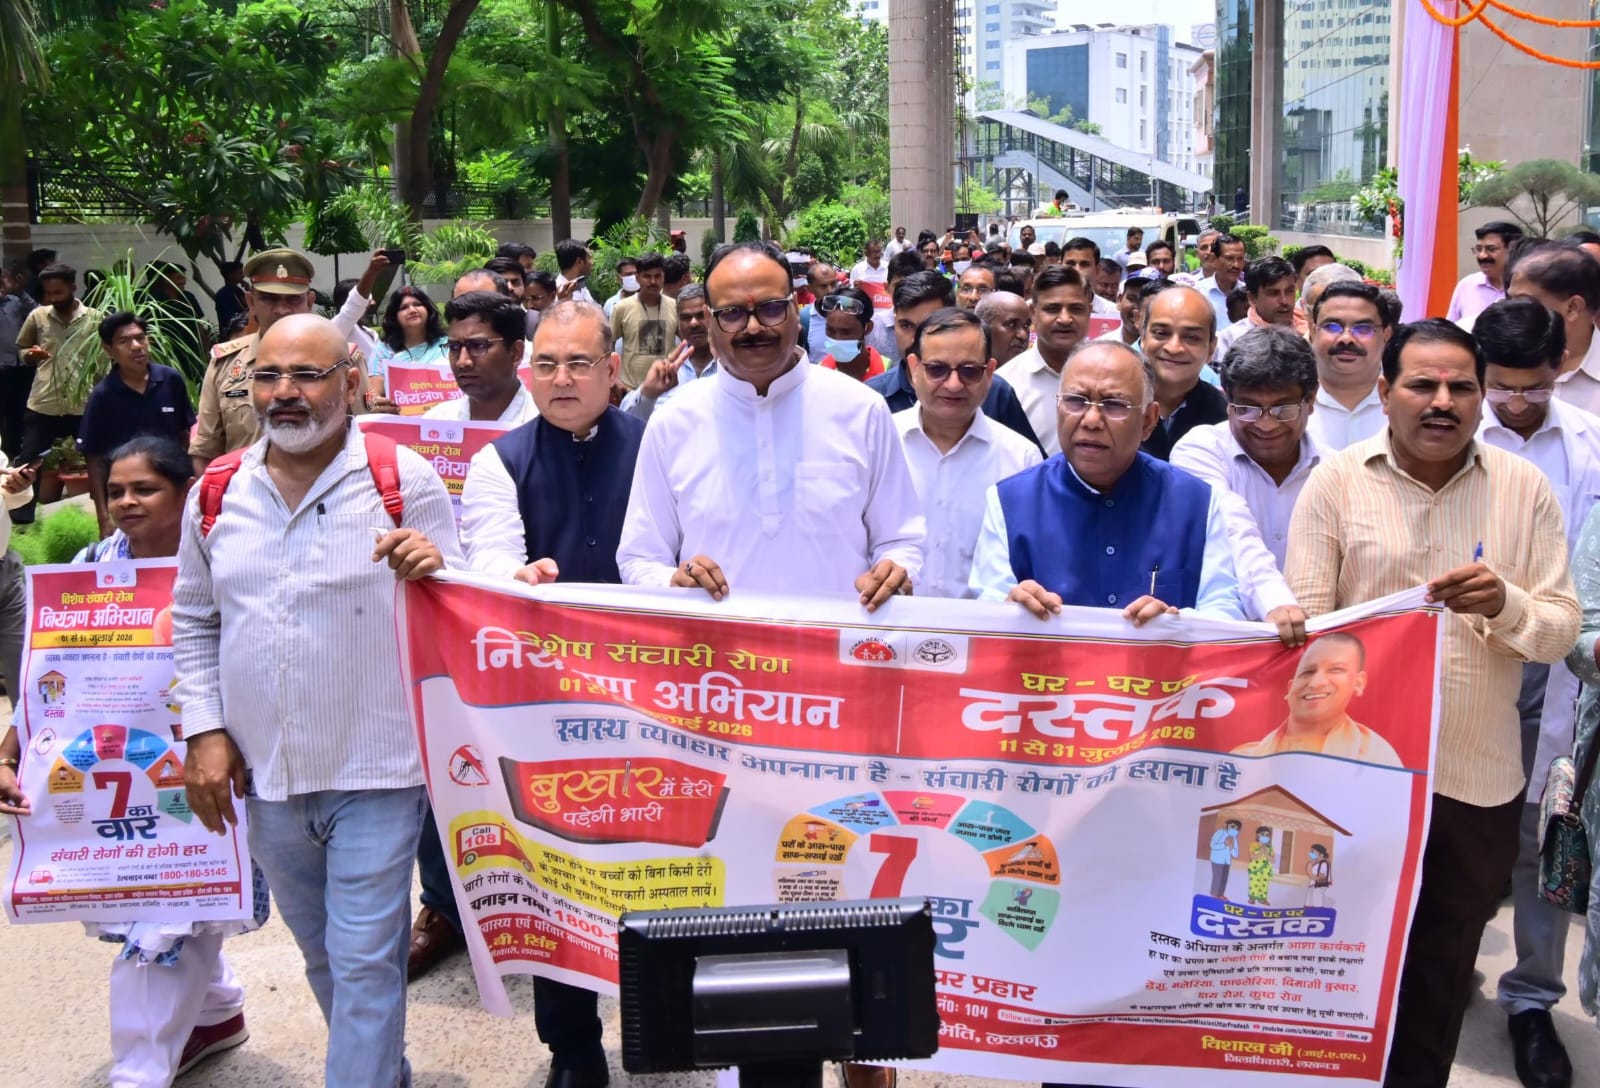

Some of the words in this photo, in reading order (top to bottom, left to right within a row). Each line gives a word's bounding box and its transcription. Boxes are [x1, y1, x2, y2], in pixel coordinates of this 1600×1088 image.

[442, 444, 461, 456] रोग
[62, 592, 84, 605] विशेष
[86, 591, 113, 604] संचारी
[116, 590, 135, 603] रोग
[39, 606, 90, 629] नियंत्रण
[91, 603, 155, 627] अभियान
[604, 640, 716, 668] संचारी
[725, 648, 793, 674] रोग
[1021, 672, 1069, 692] घर
[1107, 675, 1154, 695] घर
[560, 677, 581, 692] 01
[708, 720, 753, 737] 2026
[653, 671, 846, 729] अभियान
[960, 677, 1248, 740] दस्तक
[44, 709, 65, 719] दस्तक
[998, 740, 1017, 752] 11
[1022, 739, 1048, 757] से
[1053, 746, 1073, 758] 31
[1152, 726, 1196, 741] 2026
[555, 718, 630, 742] स्वस्थ
[638, 722, 731, 762] व्यवहार
[741, 753, 858, 782] अपनाना
[867, 760, 890, 783] है
[923, 765, 1008, 792] संचारी
[1016, 770, 1079, 796] रोगों
[1128, 760, 1208, 786] हराना
[1218, 761, 1241, 791] है
[92, 772, 132, 819] 7
[530, 765, 663, 814] बुखार
[659, 777, 678, 797] में
[680, 777, 715, 797] देरी
[127, 805, 153, 816] का
[563, 804, 616, 828] पड़ेगी
[620, 802, 664, 823] भारी
[92, 816, 160, 841] वार
[465, 834, 497, 848] 108
[472, 827, 491, 835] Call
[51, 846, 89, 862] संचारी
[93, 846, 124, 860] रोगों
[125, 844, 144, 860] की
[146, 843, 178, 858] होगी
[182, 844, 208, 856] हार
[782, 840, 795, 849] घरों
[797, 840, 806, 848] के
[808, 841, 846, 851] आस-पास
[160, 868, 227, 880] 1800-180-5145
[543, 850, 566, 864] बुखार
[569, 859, 583, 872] होने
[586, 866, 596, 876] पर
[600, 867, 625, 881] बच्चों
[628, 864, 642, 880] को
[645, 864, 665, 879] बिना
[669, 862, 693, 877] किसी
[697, 862, 712, 876] देरी
[869, 833, 918, 899] 7
[487, 871, 510, 885] रोगों
[513, 873, 524, 885] के
[552, 897, 581, 915] अधिक
[538, 861, 548, 872] के
[551, 867, 577, 881] उपचार
[579, 875, 589, 886] के
[590, 880, 608, 893] लिए
[611, 887, 646, 900] सरकारी
[650, 887, 688, 900] अस्पताल
[522, 894, 551, 917] नम्बर
[554, 910, 619, 944] 1800-1
[1197, 907, 1331, 937] दस्तक
[1224, 904, 1245, 916] घर
[1262, 910, 1281, 918] घर
[524, 932, 558, 951] सिंह
[1150, 931, 1181, 948] दस्तक
[1184, 939, 1229, 952] अभियान
[1232, 942, 1244, 951] के
[1287, 942, 1316, 950] आशा
[971, 976, 1038, 1001] प्रहार
[965, 1004, 989, 1019] 104
[986, 1031, 1060, 1048] लखनऊ
[1202, 1035, 1266, 1055] विशाख
[1269, 1040, 1294, 1057] जी
[1225, 1054, 1294, 1068] जिलाधिकारी,
[1296, 1060, 1341, 1071] लखनऊ
